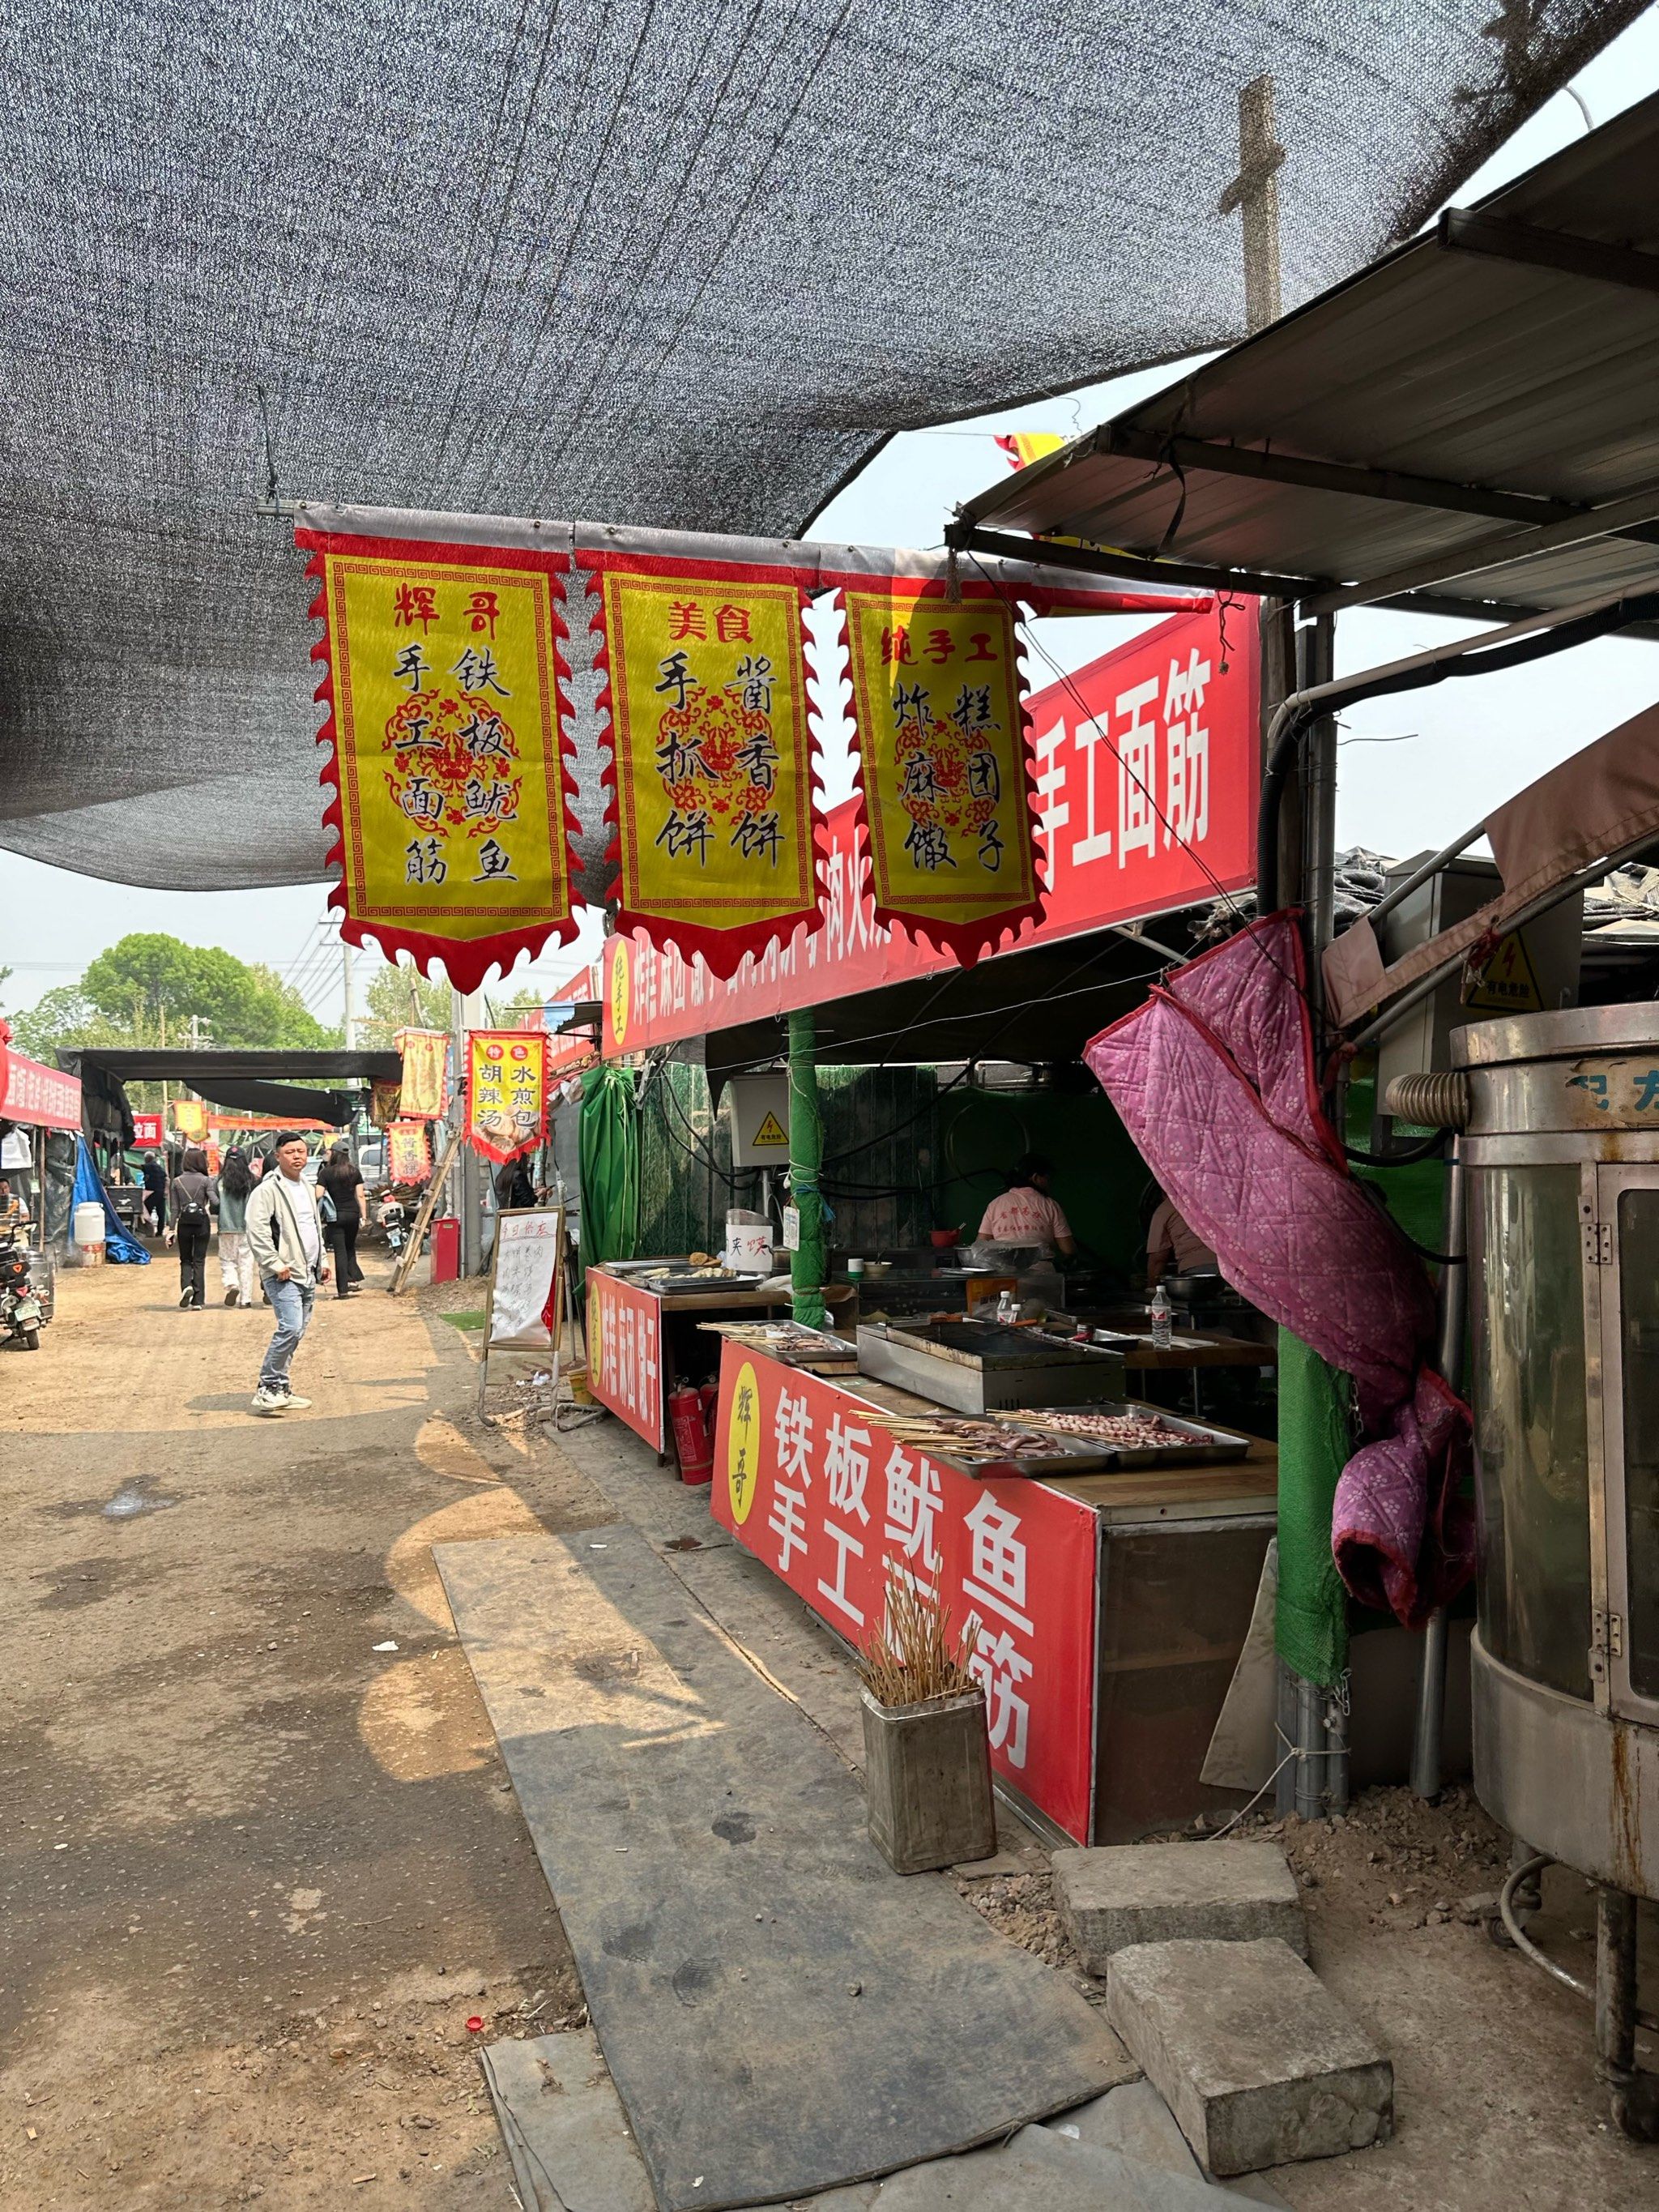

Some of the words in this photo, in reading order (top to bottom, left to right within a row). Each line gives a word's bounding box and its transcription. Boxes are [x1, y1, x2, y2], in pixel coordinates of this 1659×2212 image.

[393, 582, 501, 641] 辉哥
[667, 600, 753, 644] 美食
[881, 625, 998, 667] 纯手工
[393, 643, 447, 886] 手工面筋
[448, 647, 518, 884] 铁板鱿鱼
[655, 651, 718, 869] 手抓饼
[725, 655, 785, 870] 酱香饼
[1034, 647, 1211, 893] 手工面筋
[1486, 980, 1530, 998] 有电危险
[477, 1064, 503, 1127] 胡辣汤
[488, 1046, 527, 1059] 特色
[510, 1065, 536, 1128] 水煎包
[731, 1385, 754, 1510] 辉哥
[774, 1386, 1034, 1638] 铁板鱿鱼
